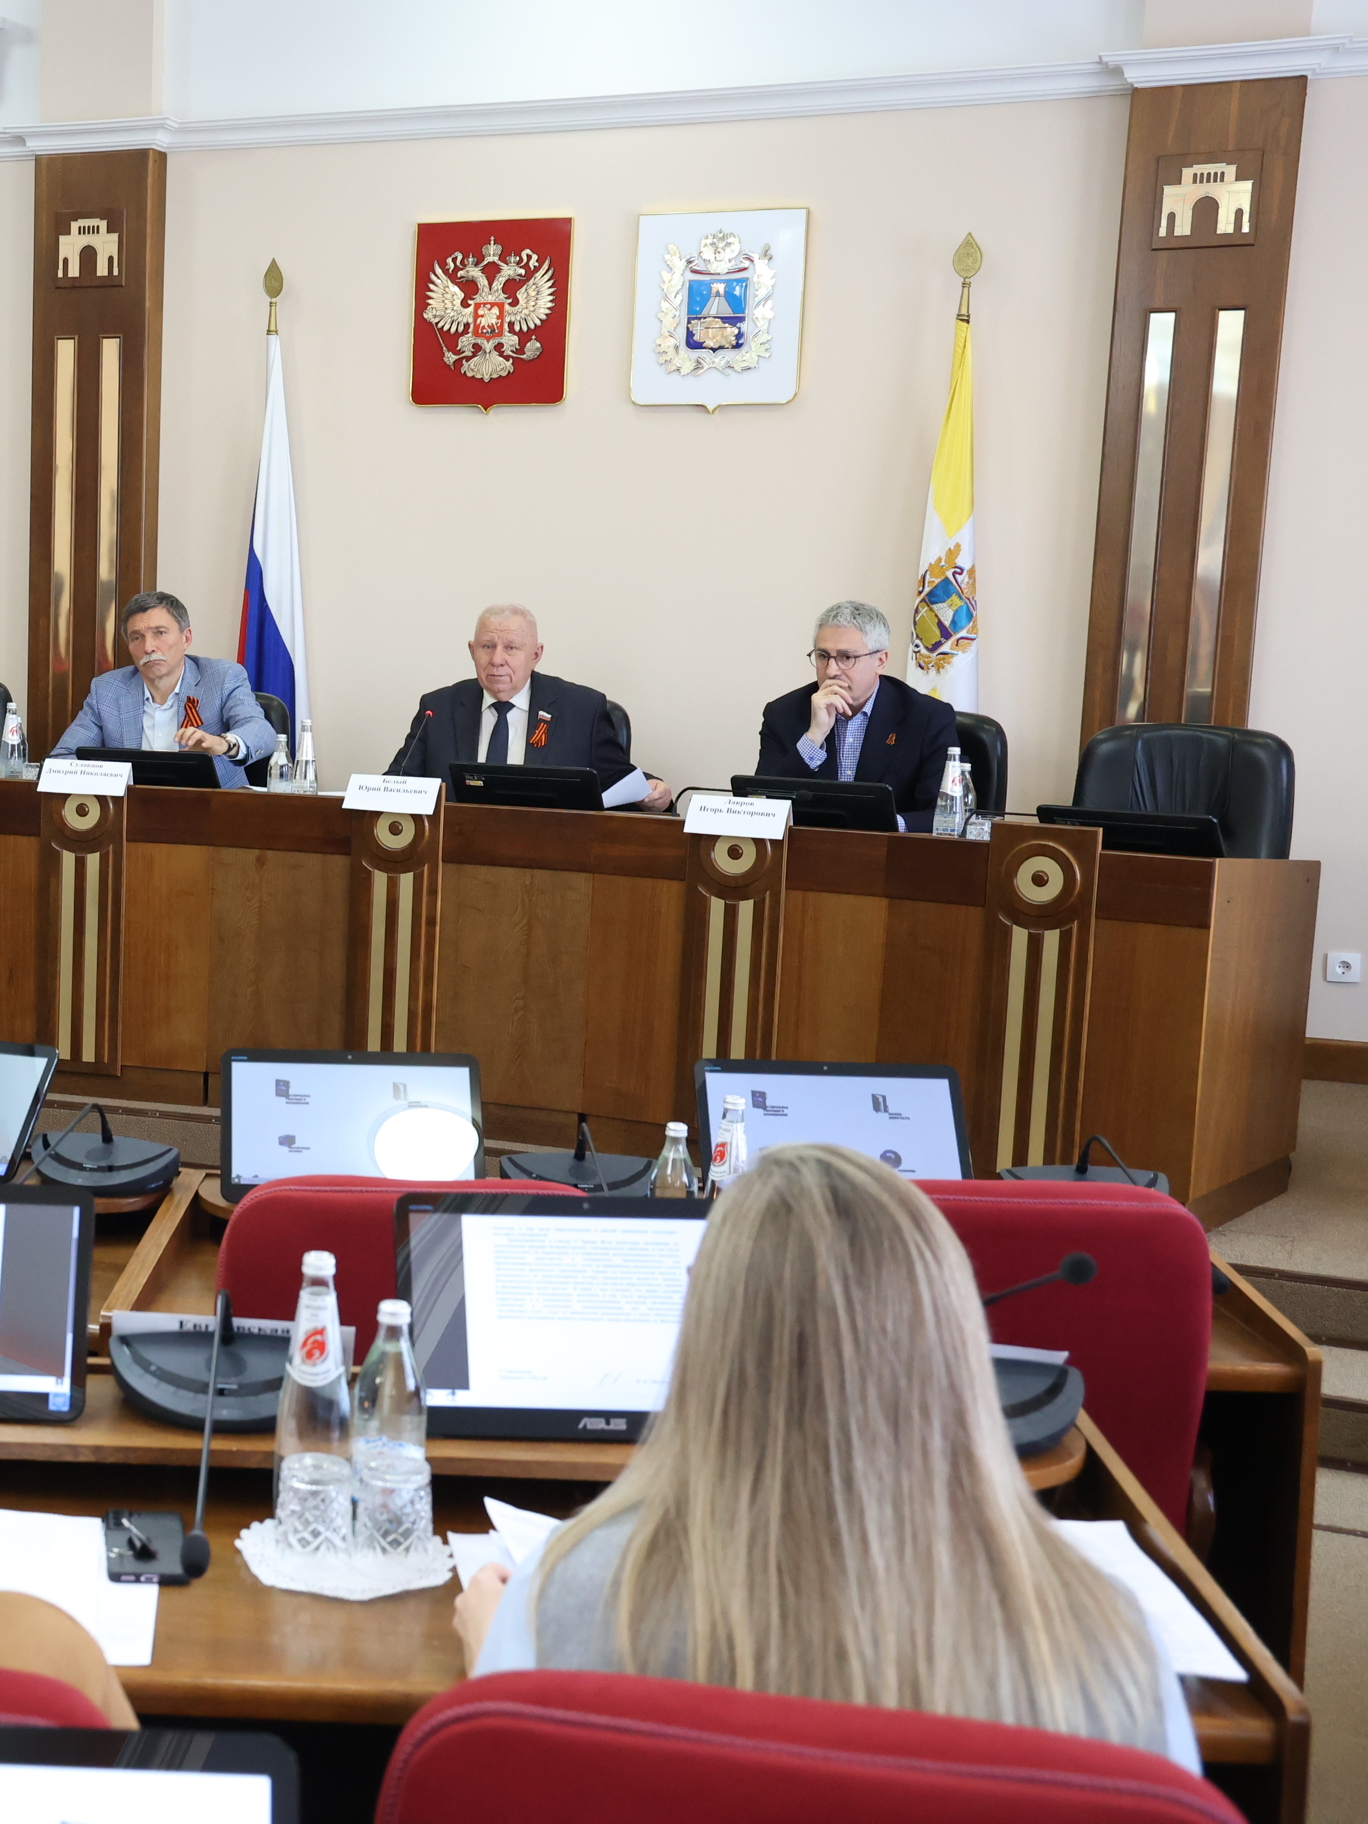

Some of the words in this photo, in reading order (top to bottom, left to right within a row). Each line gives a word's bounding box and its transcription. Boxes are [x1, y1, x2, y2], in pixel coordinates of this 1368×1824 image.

[45, 767, 78, 777] Дмитрий
[79, 769, 123, 779] Николаевич
[358, 784, 382, 793] Юрий
[383, 786, 428, 795] Васильевич
[724, 799, 755, 807] Лавров
[699, 805, 724, 815] Игорь
[726, 807, 776, 818] Викторович
[578, 1416, 628, 1430] ASUS
